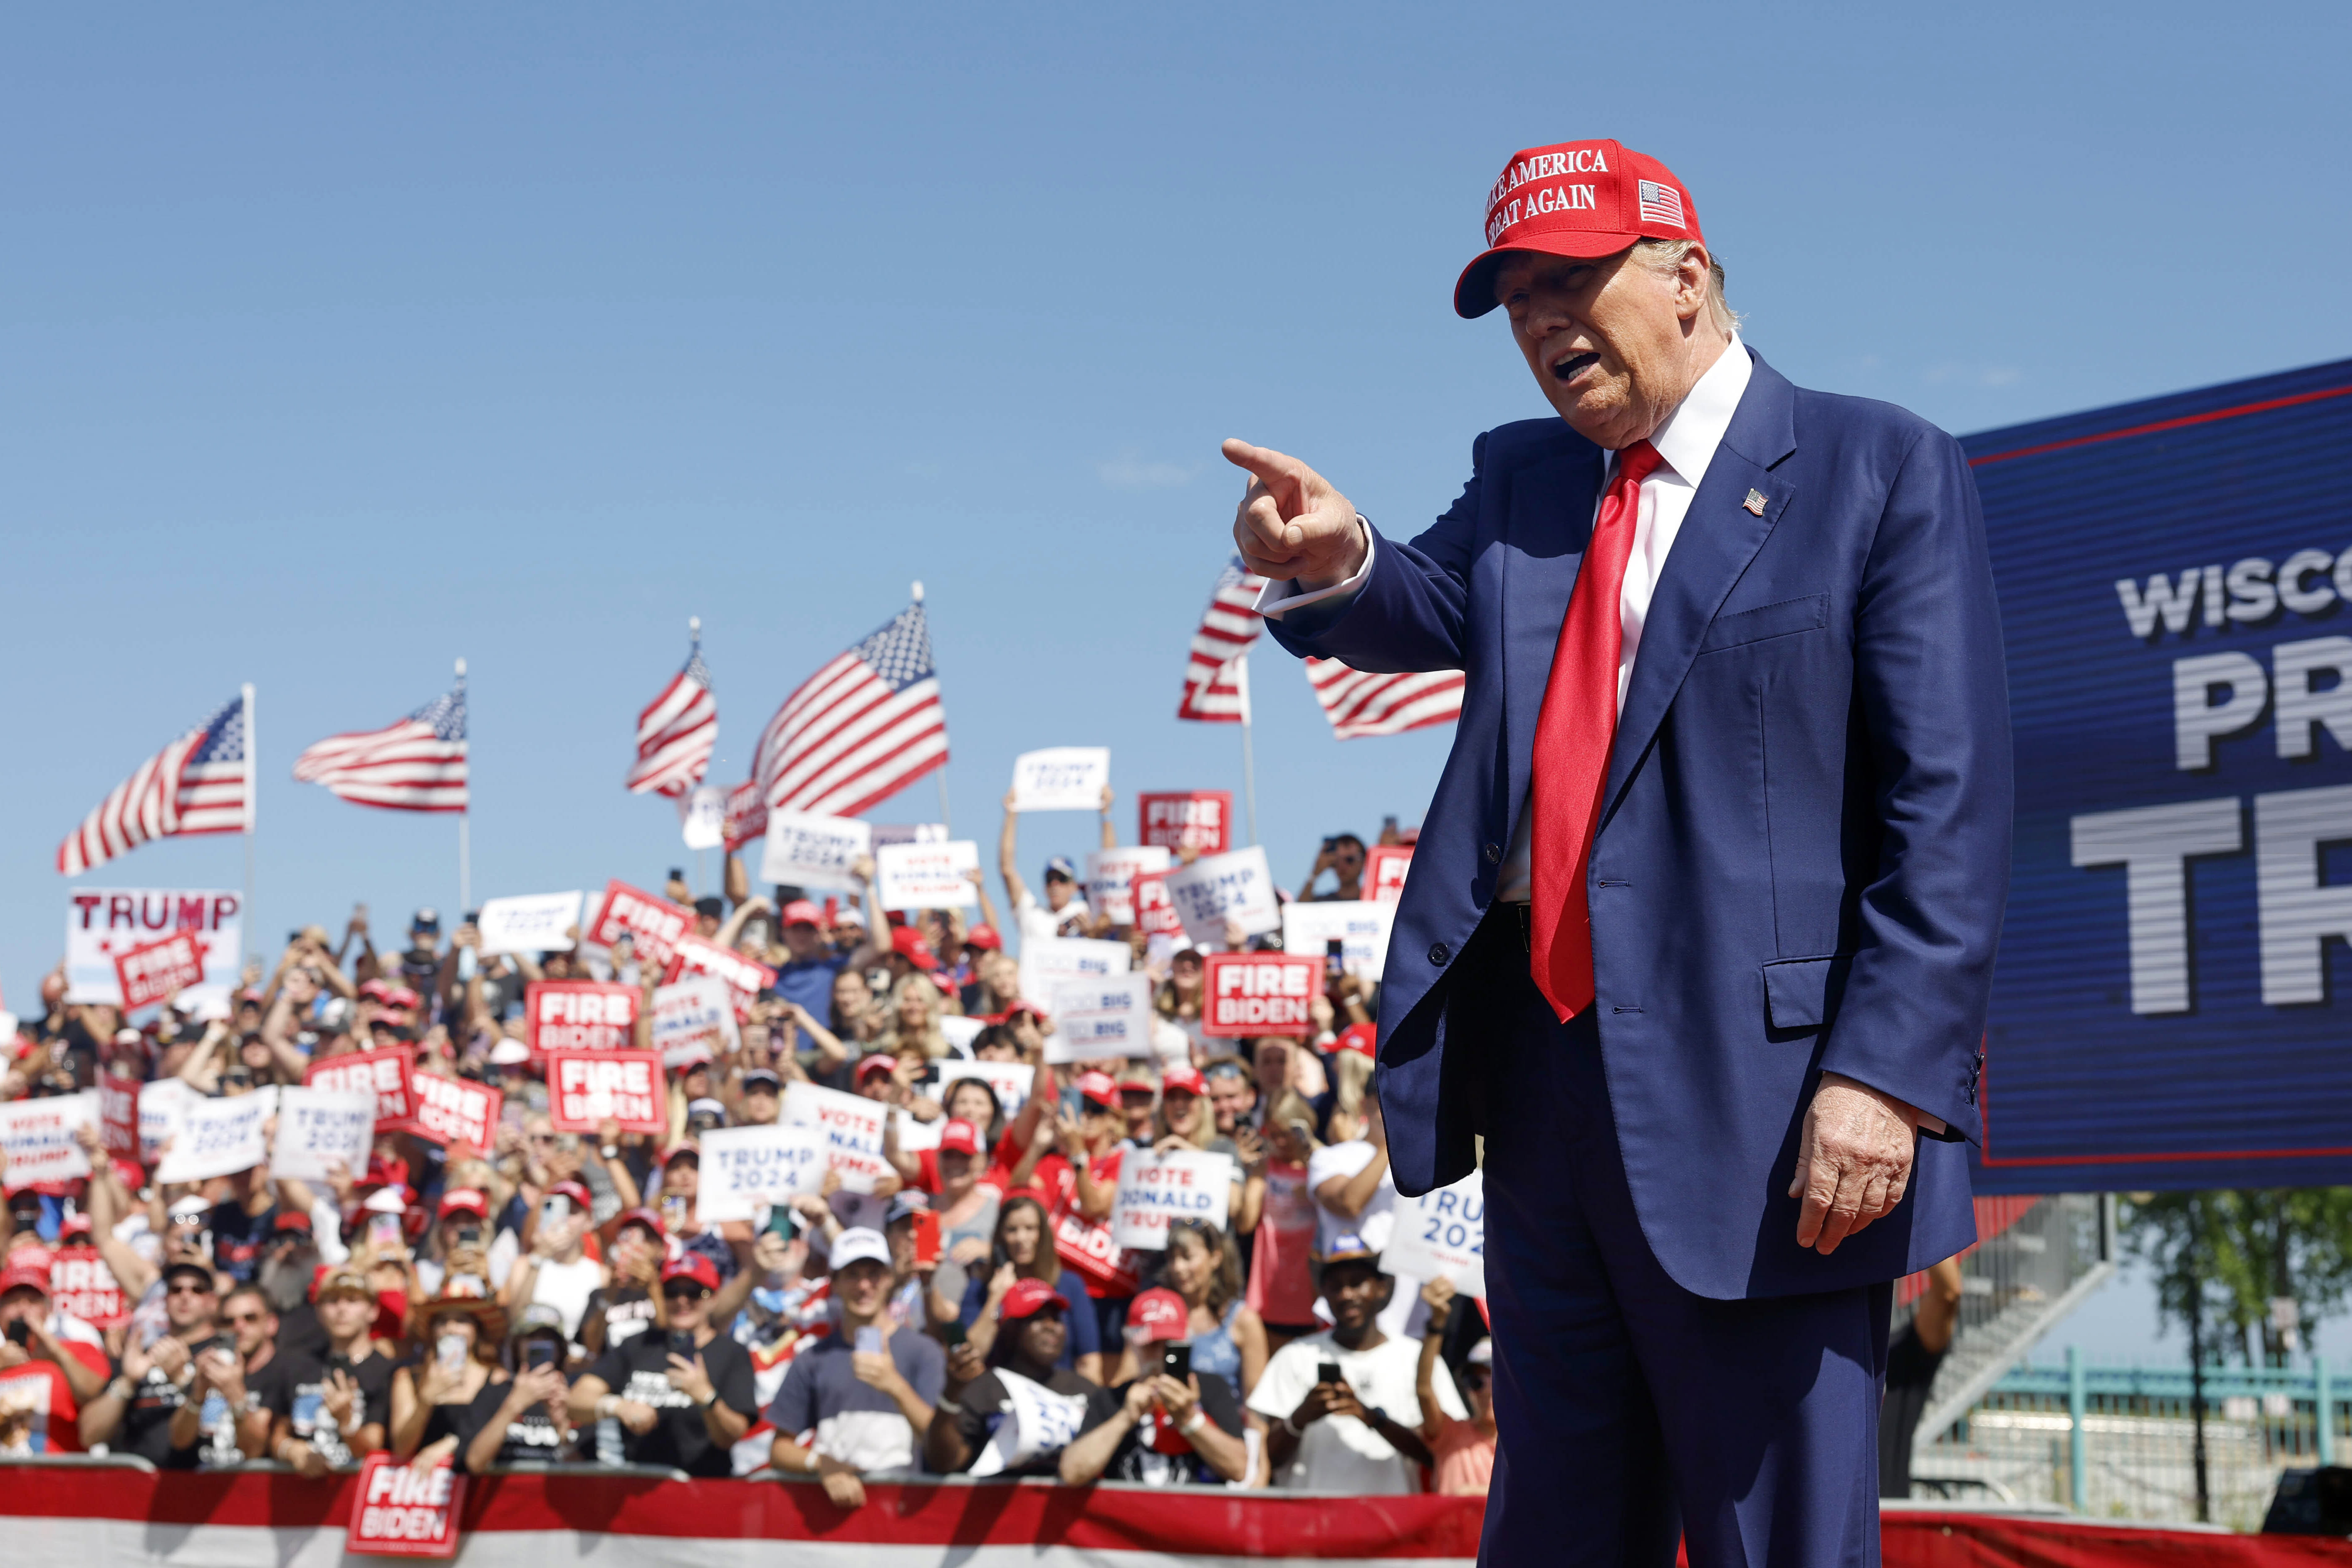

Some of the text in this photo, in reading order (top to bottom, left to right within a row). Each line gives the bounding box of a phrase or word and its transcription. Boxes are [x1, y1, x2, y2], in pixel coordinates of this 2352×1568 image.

[1508, 149, 1609, 193] AMERICA
[1524, 184, 1595, 219] AGAIN
[1027, 763, 1095, 773] TRUMP
[1147, 799, 1222, 827] FIRE
[782, 825, 857, 848] TRUMP
[1147, 827, 1221, 848] BIDEN
[790, 845, 845, 866] 2024
[907, 855, 951, 866] VOTE
[1177, 867, 1254, 900] TRUMP
[1378, 858, 1411, 885] FI
[901, 882, 961, 893] TRUMP
[1139, 881, 1169, 910] FI
[70, 895, 238, 931] TRUMP
[608, 892, 685, 943] FIRE
[1140, 909, 1181, 932] BID
[1194, 892, 1246, 921] 2024
[123, 936, 194, 981] FIRE
[127, 968, 199, 1004] BIDEN
[1218, 965, 1309, 997] FIRE
[539, 991, 631, 1026] FIRE
[1217, 997, 1308, 1024] BIDEN
[312, 1057, 403, 1093] FIRE
[561, 1059, 651, 1095] FIRE
[8, 1114, 61, 1130] VOTE
[186, 1106, 260, 1132] TRUMP
[418, 1103, 485, 1144] IDEN
[818, 1103, 877, 1134] VOTE
[194, 1129, 248, 1153] 2024
[10, 1150, 70, 1166] TRUMP
[717, 1148, 814, 1167] TRUMP
[829, 1153, 882, 1174] UMP
[729, 1169, 798, 1190] 2024
[1123, 1210, 1171, 1229] TRU
[1423, 1217, 1484, 1256] 202
[51, 1259, 119, 1291] IRE
[53, 1292, 119, 1318] DEN
[368, 1464, 453, 1507] FIRE
[360, 1506, 448, 1540] BIDEN
